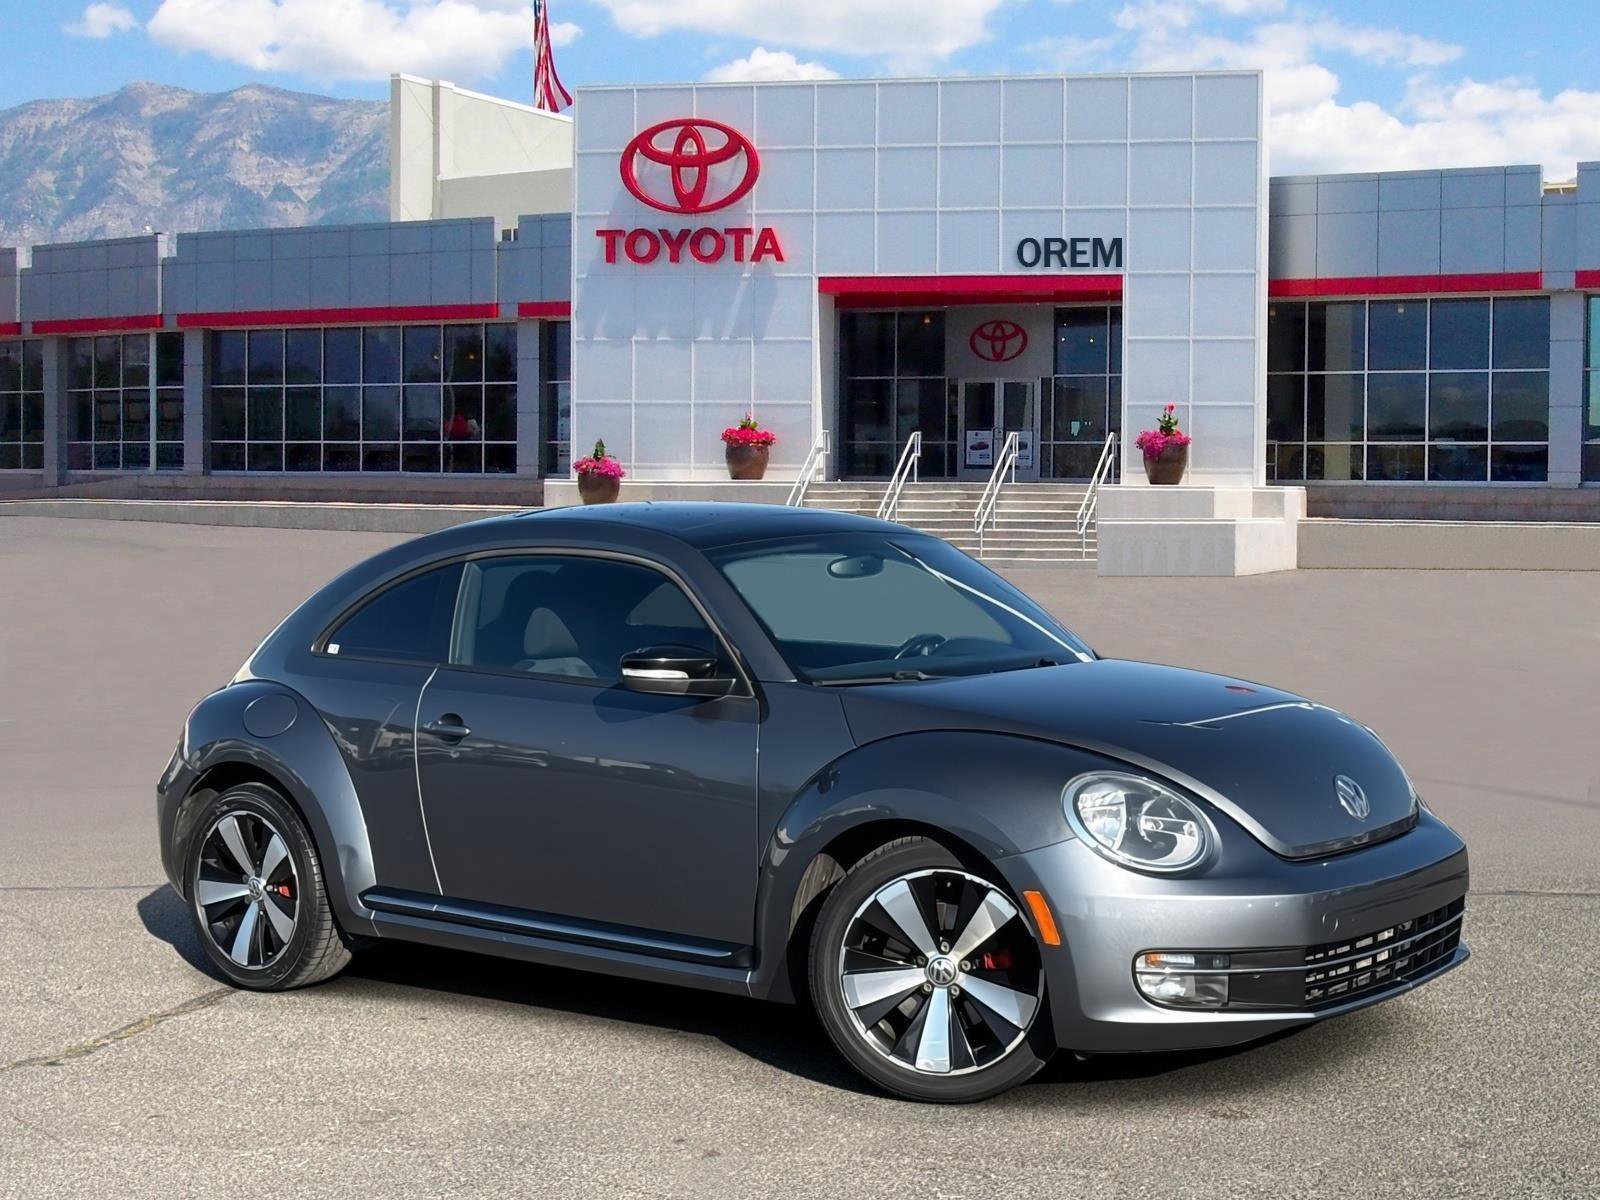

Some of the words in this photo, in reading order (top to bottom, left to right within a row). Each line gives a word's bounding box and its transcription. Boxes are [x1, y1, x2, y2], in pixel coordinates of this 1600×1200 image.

[596, 228, 785, 264] TOYOTA
[1016, 237, 1123, 268] OREM
[1335, 774, 1370, 822] VW
